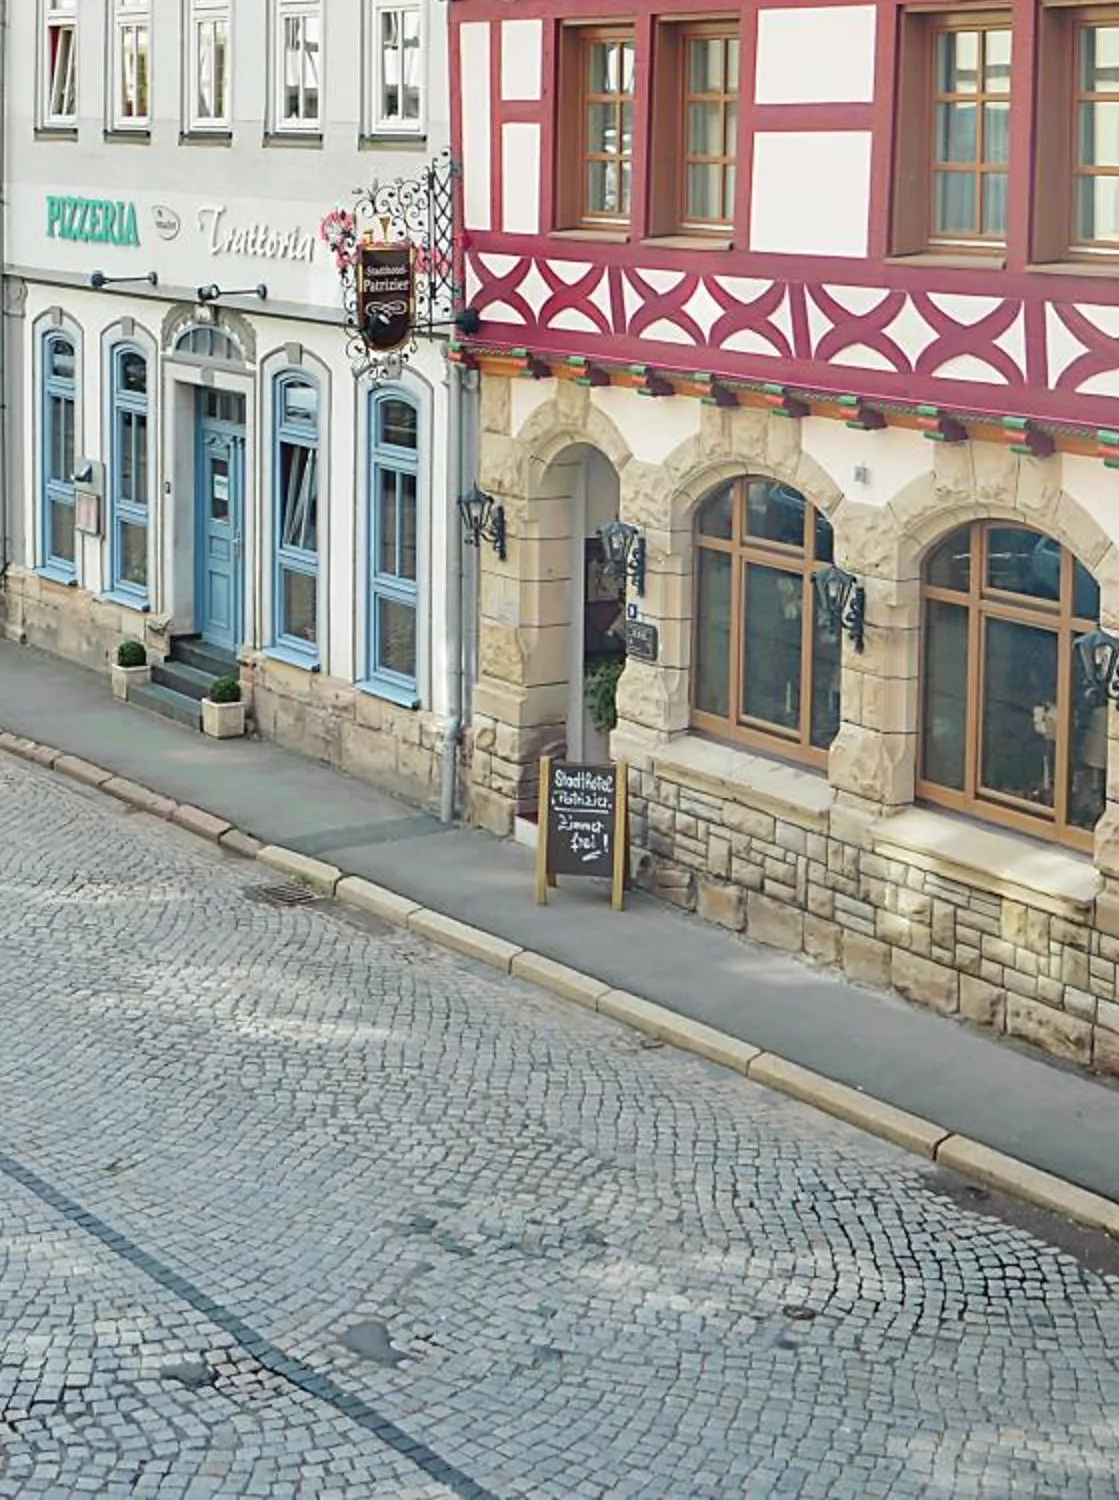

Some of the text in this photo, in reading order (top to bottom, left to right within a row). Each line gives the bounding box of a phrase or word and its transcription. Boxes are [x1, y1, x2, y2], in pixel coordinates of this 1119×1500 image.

[46, 195, 316, 263] PIZZERIA Trattoria
[363, 278, 409, 293] Patrizier
[558, 813, 604, 833] Zimmer
